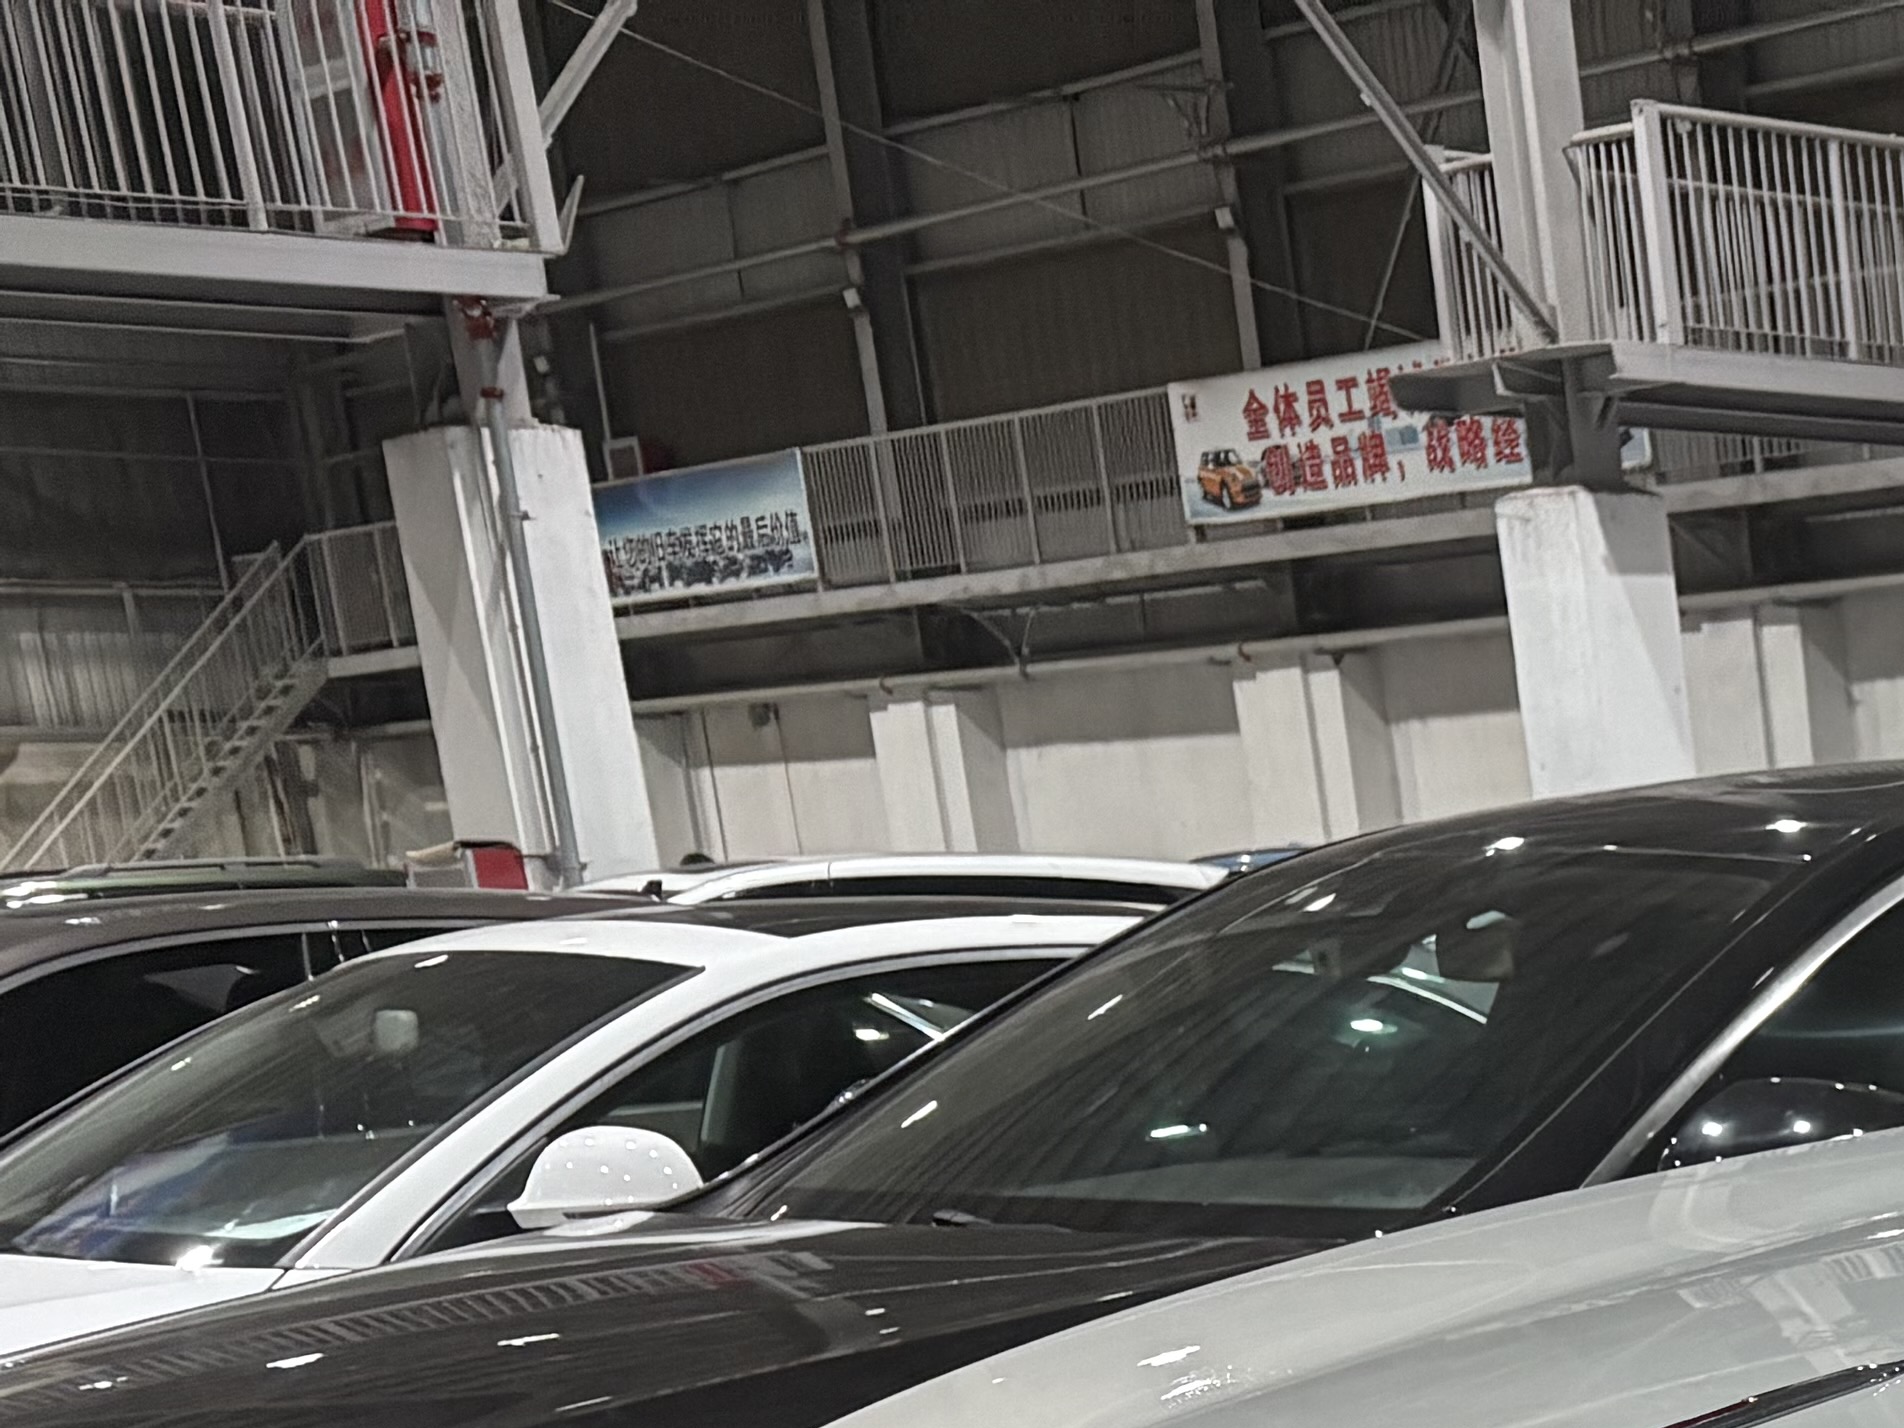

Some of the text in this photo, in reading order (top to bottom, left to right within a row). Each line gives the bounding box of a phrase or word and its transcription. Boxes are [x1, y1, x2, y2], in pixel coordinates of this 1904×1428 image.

[1242, 358, 1450, 442] 全体员工竭
